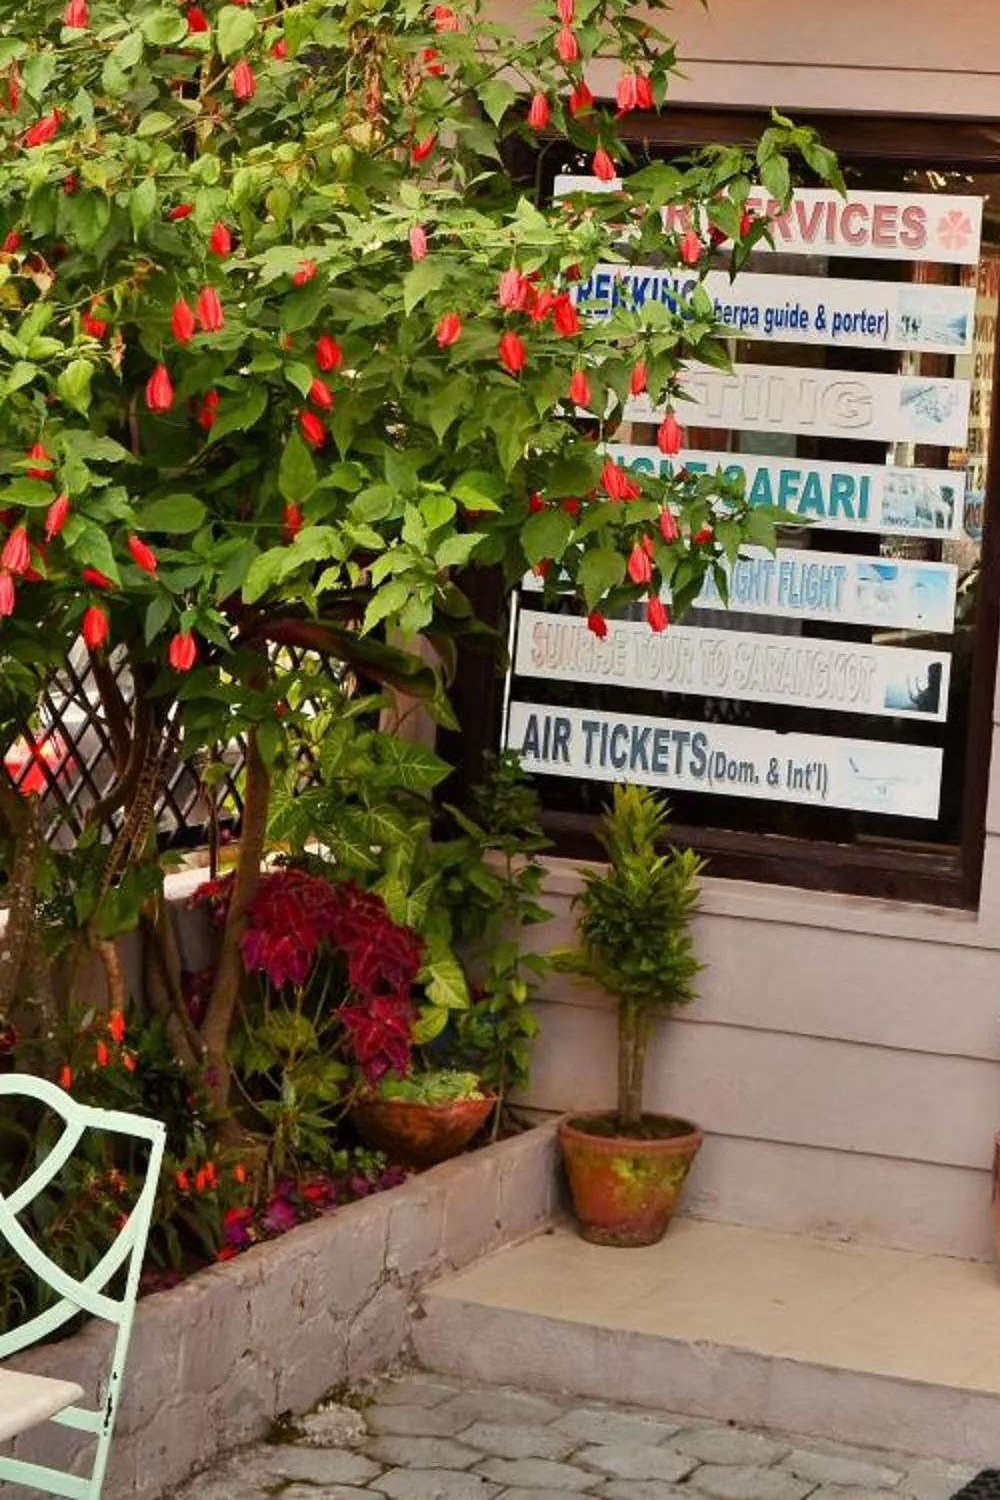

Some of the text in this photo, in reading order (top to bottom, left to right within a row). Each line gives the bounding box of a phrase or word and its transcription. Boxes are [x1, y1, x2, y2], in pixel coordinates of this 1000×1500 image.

[714, 197, 928, 250] RVICES
[572, 273, 889, 340] REKKING herpa guide & porter)
[778, 560, 846, 612] FLIGHT
[531, 621, 878, 706] SUNRISE TOUR TO SARANGKOT
[522, 713, 572, 764] AIR
[766, 757, 779, 786] &
